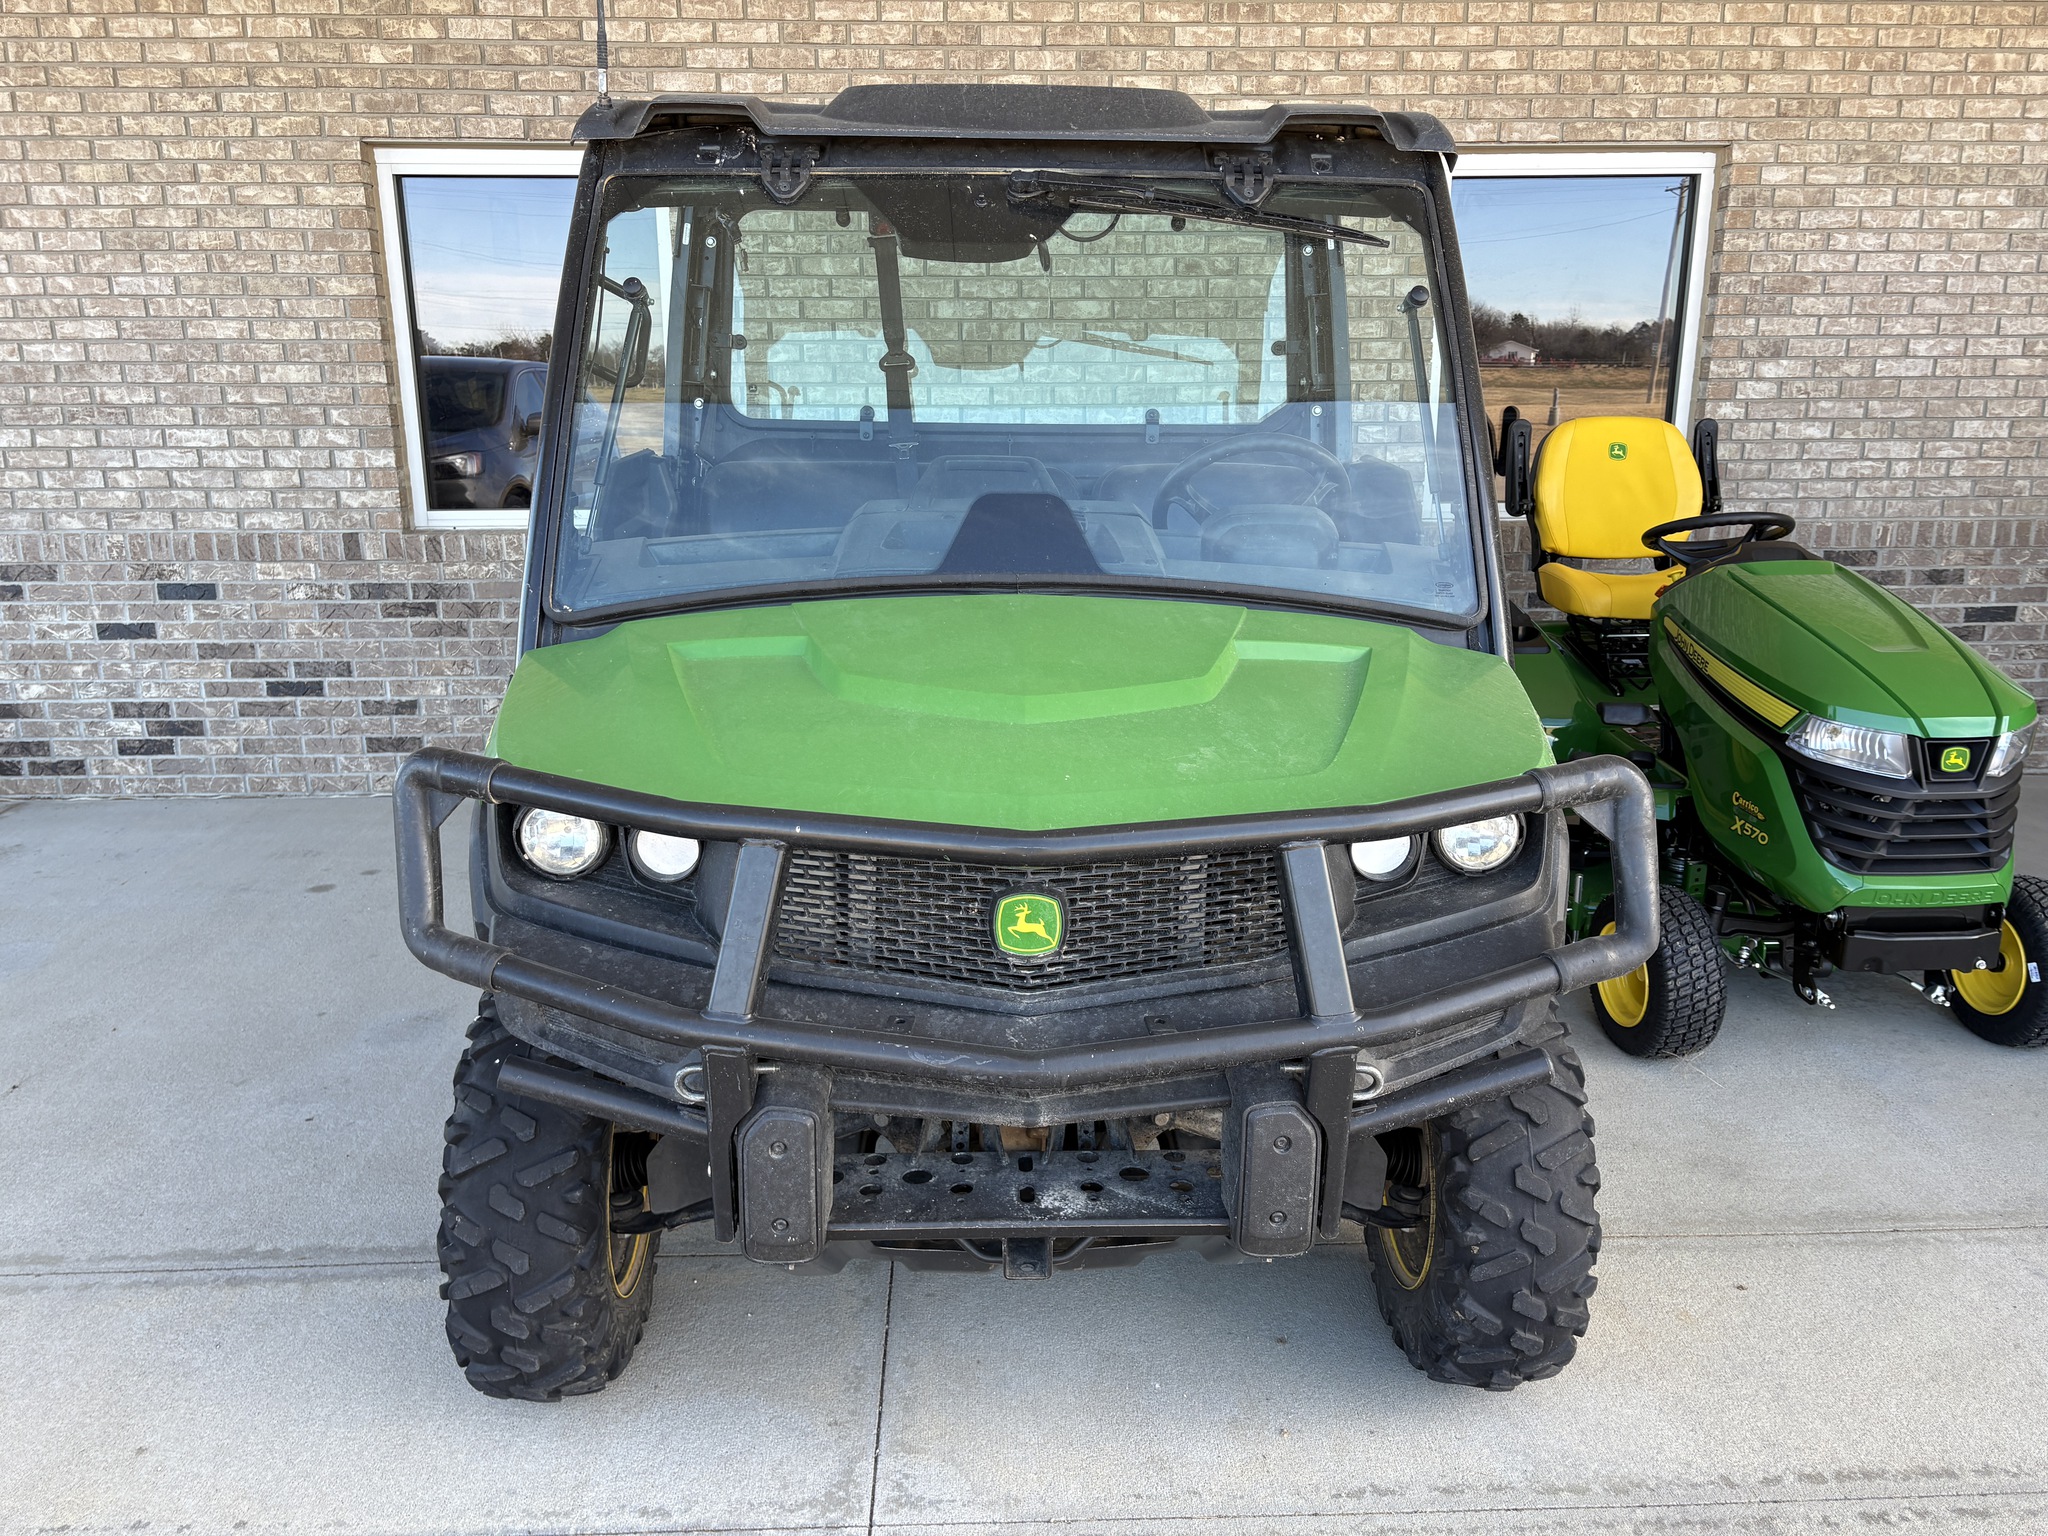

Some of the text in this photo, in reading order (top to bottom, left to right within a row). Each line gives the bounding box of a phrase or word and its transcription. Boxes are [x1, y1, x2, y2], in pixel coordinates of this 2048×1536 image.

[1674, 629, 1710, 673] JOHN DEERE
[1732, 791, 1759, 813] Carrico
[1730, 815, 1769, 845] X570
[1861, 889, 1995, 905] JOHN DEERE
